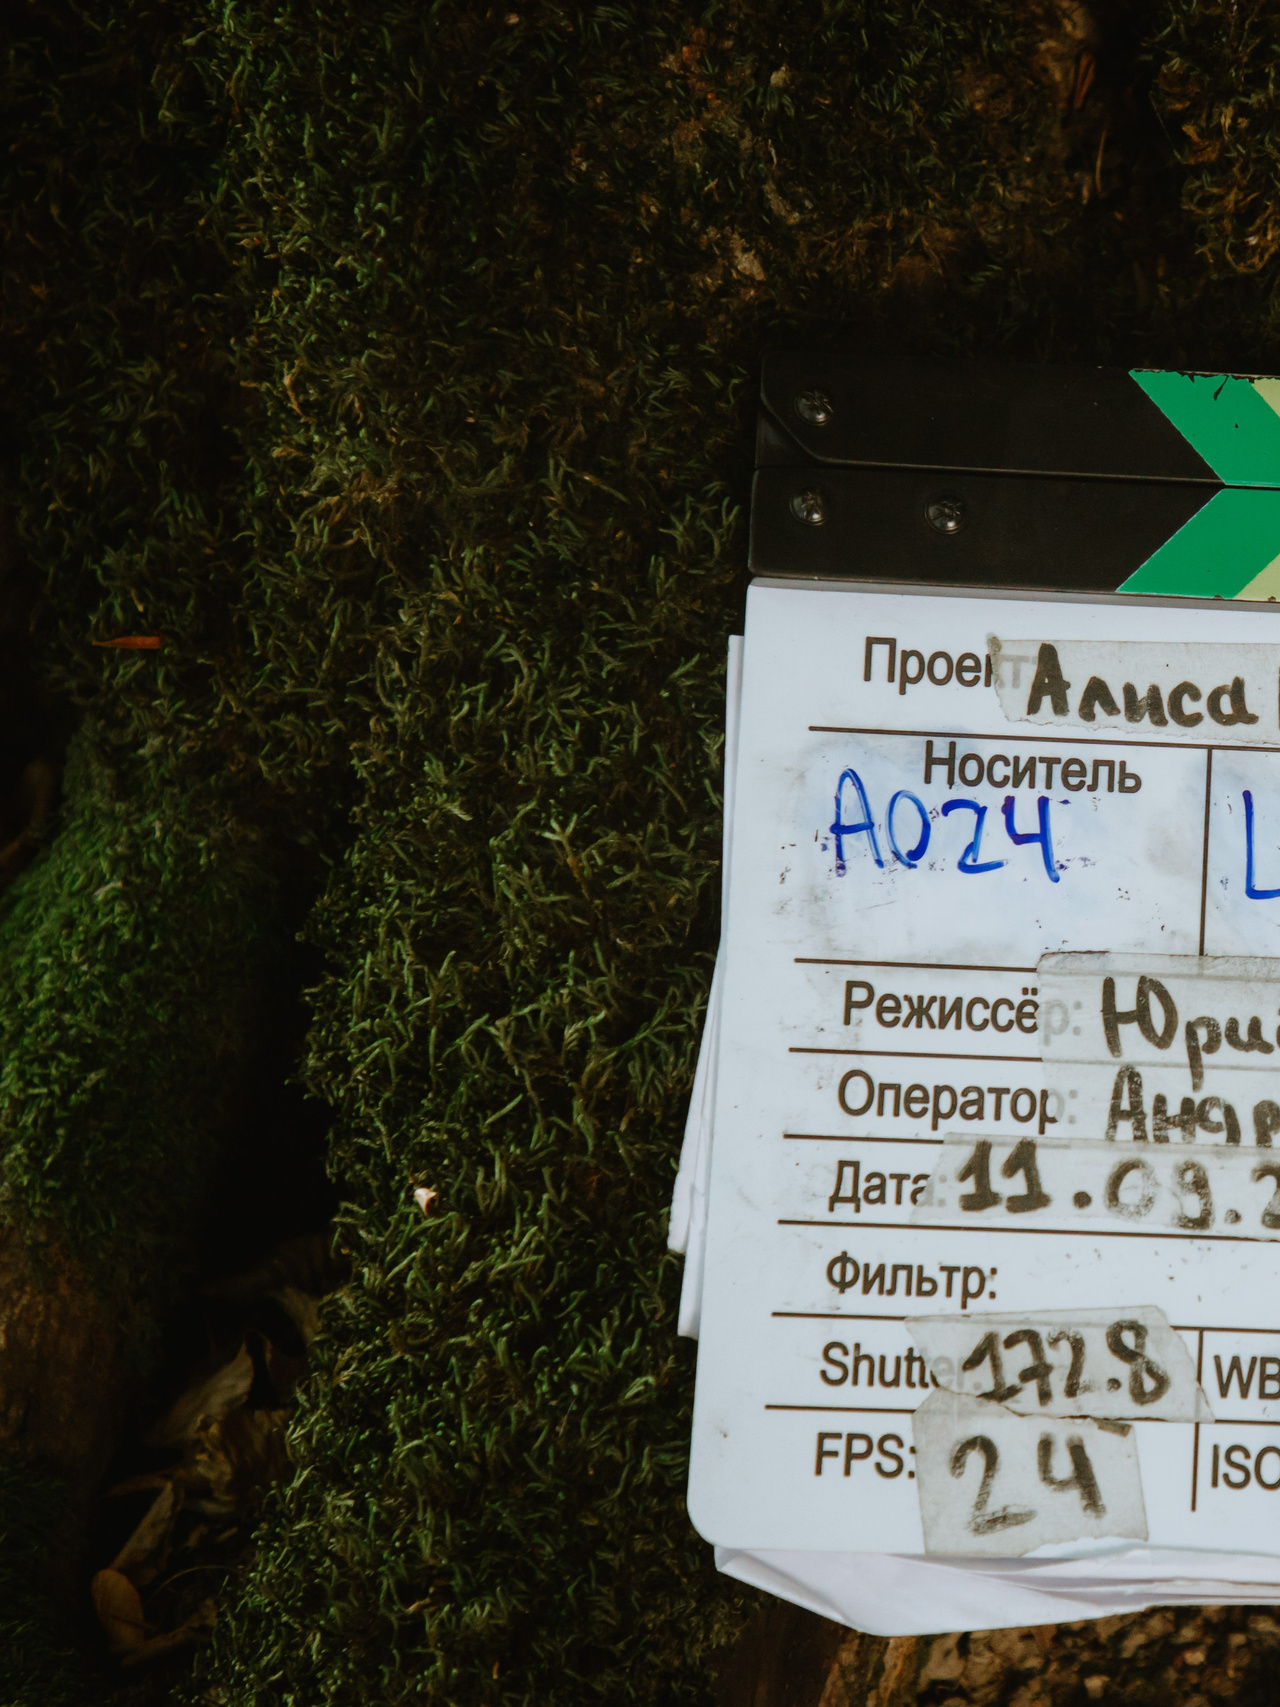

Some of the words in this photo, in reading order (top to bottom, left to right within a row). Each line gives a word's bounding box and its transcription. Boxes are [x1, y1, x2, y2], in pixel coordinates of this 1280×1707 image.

[1026, 643, 1258, 726] Алиса
[924, 740, 1142, 794] Носитель
[825, 1250, 997, 1308] Фильтр:
[814, 1432, 916, 1478] FPS:
[950, 1433, 1105, 1536] 24
